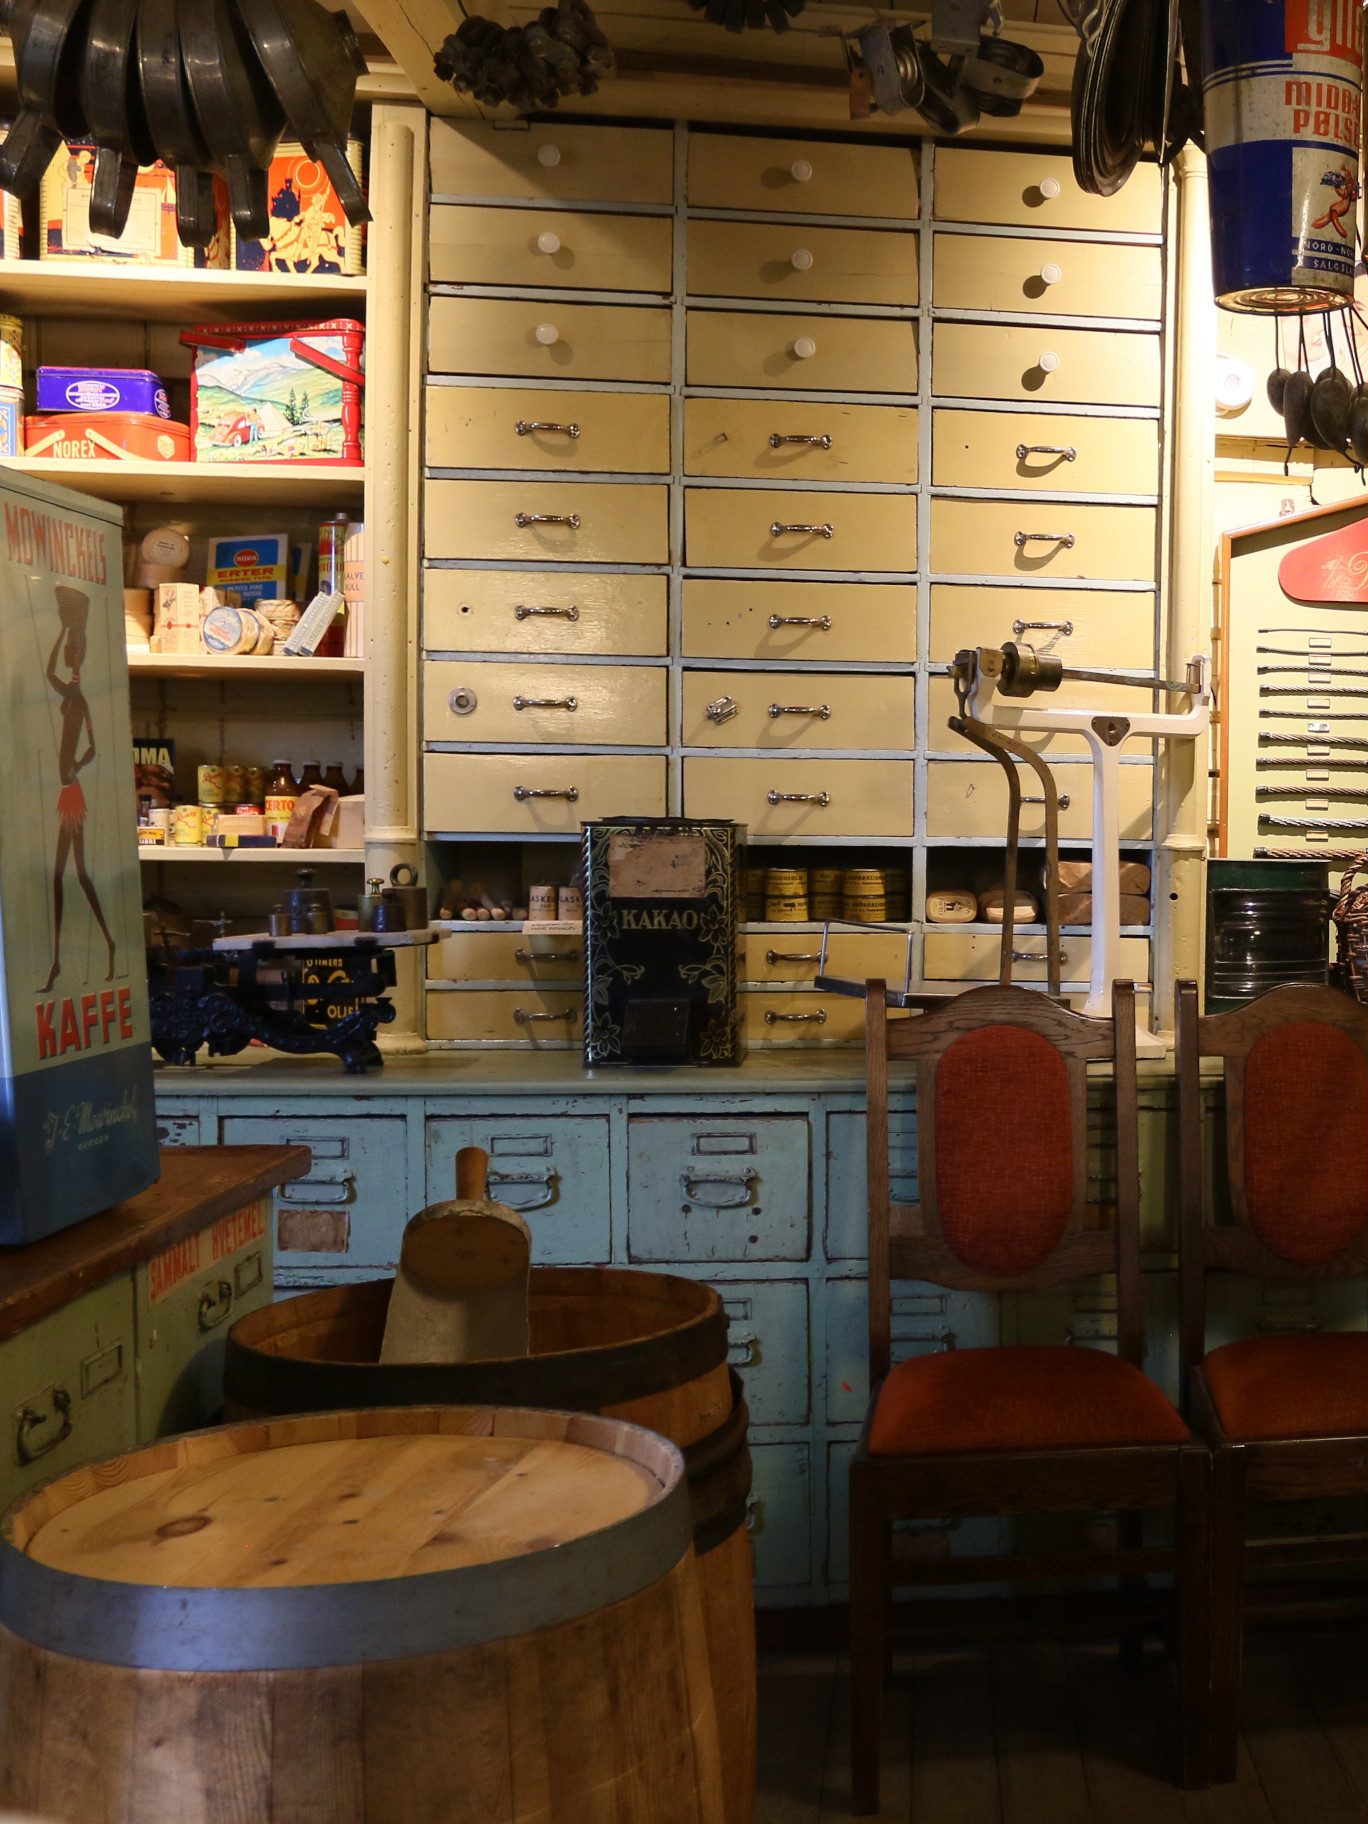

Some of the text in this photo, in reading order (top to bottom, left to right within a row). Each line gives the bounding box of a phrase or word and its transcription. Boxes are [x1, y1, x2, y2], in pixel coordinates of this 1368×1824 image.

[53, 440, 96, 458] NOREX
[4, 501, 106, 585] MOWINCKELS
[218, 567, 274, 579] ERTER
[621, 908, 698, 930] KAKAO
[35, 987, 133, 1060] KAFFE
